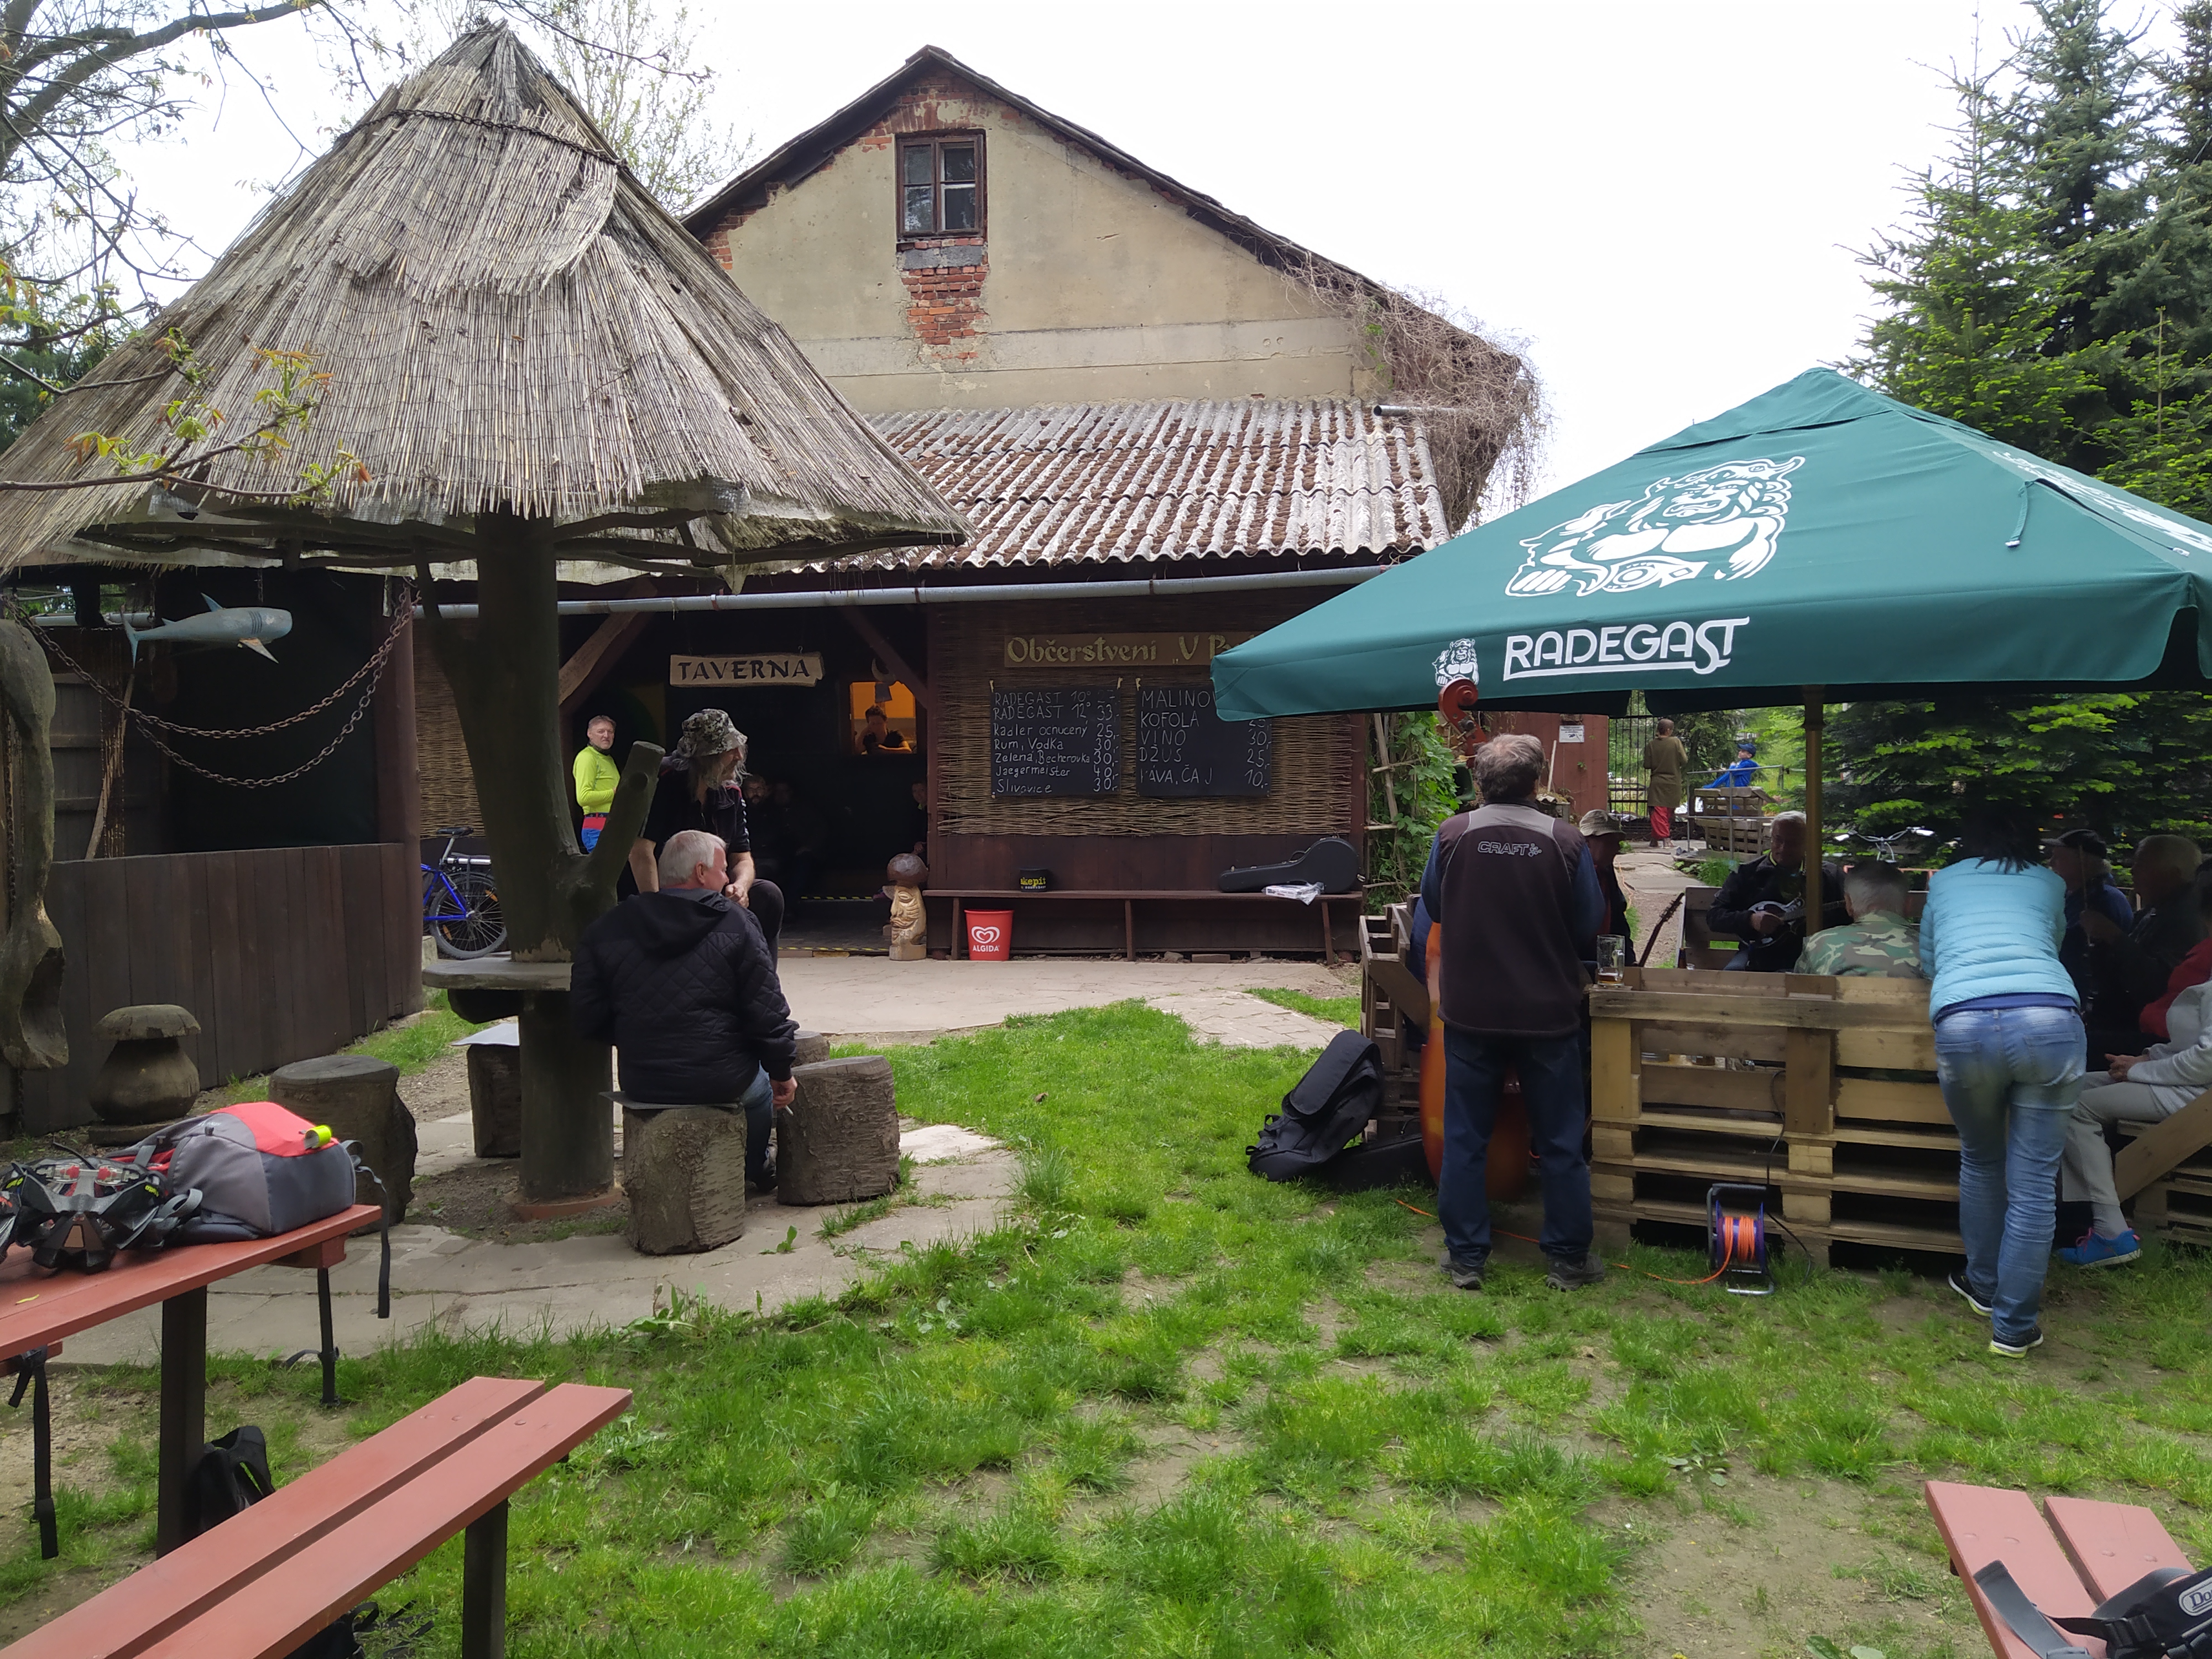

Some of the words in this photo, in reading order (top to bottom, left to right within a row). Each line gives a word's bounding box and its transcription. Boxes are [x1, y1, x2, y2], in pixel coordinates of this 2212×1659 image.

[1504, 616, 1750, 682] RADEGAST
[677, 659, 810, 680] TAVERNA
[995, 692, 1061, 706] RADEGAST
[1071, 690, 1091, 702] 10°
[993, 705, 1064, 719] RADEGAST
[1140, 710, 1199, 728] KOFOLA
[993, 723, 1033, 737] Radler
[995, 765, 1071, 778] Jaegermeister
[996, 778, 1052, 794] Slivovice
[1478, 841, 1529, 855] CRAFT
